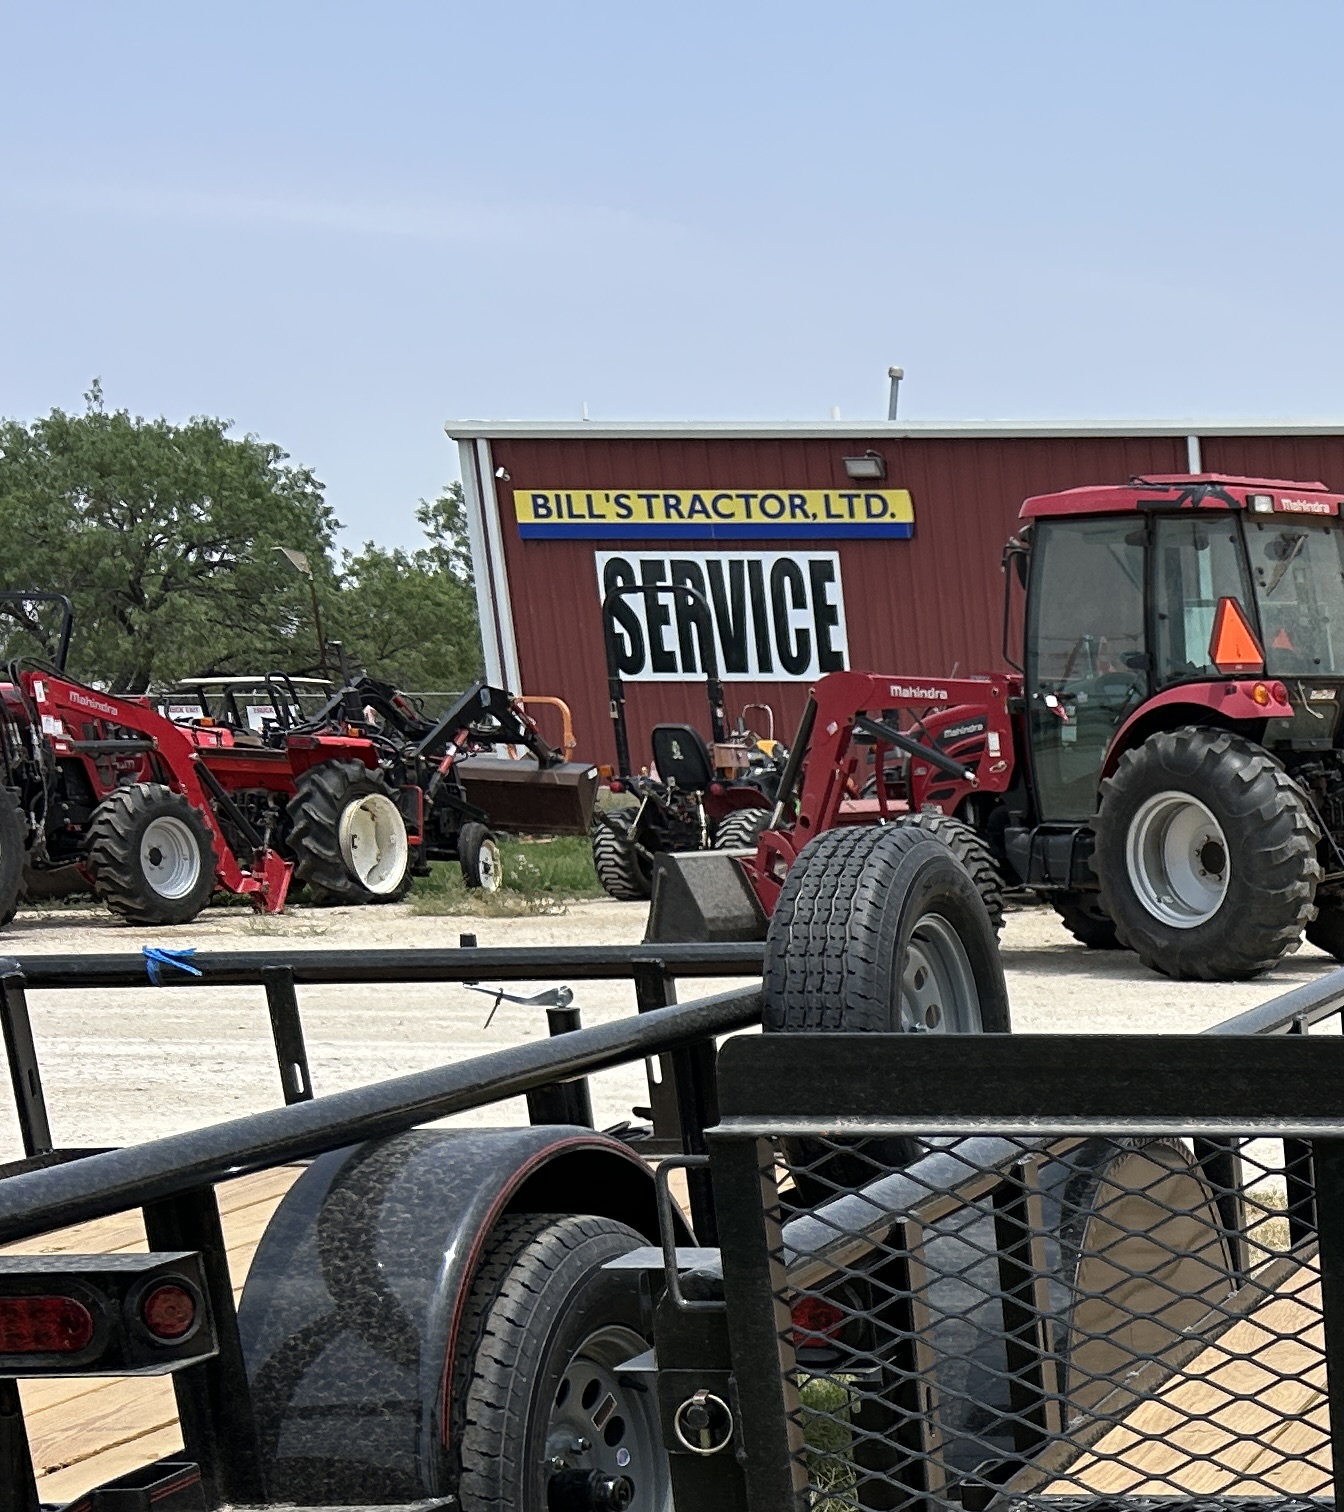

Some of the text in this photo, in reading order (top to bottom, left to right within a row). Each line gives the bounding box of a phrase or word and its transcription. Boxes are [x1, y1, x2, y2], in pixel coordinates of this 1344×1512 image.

[531, 493, 897, 522] BILL'S TRACTOR, LTD.
[604, 557, 845, 676] SERVICE
[890, 685, 948, 700] Mahindra
